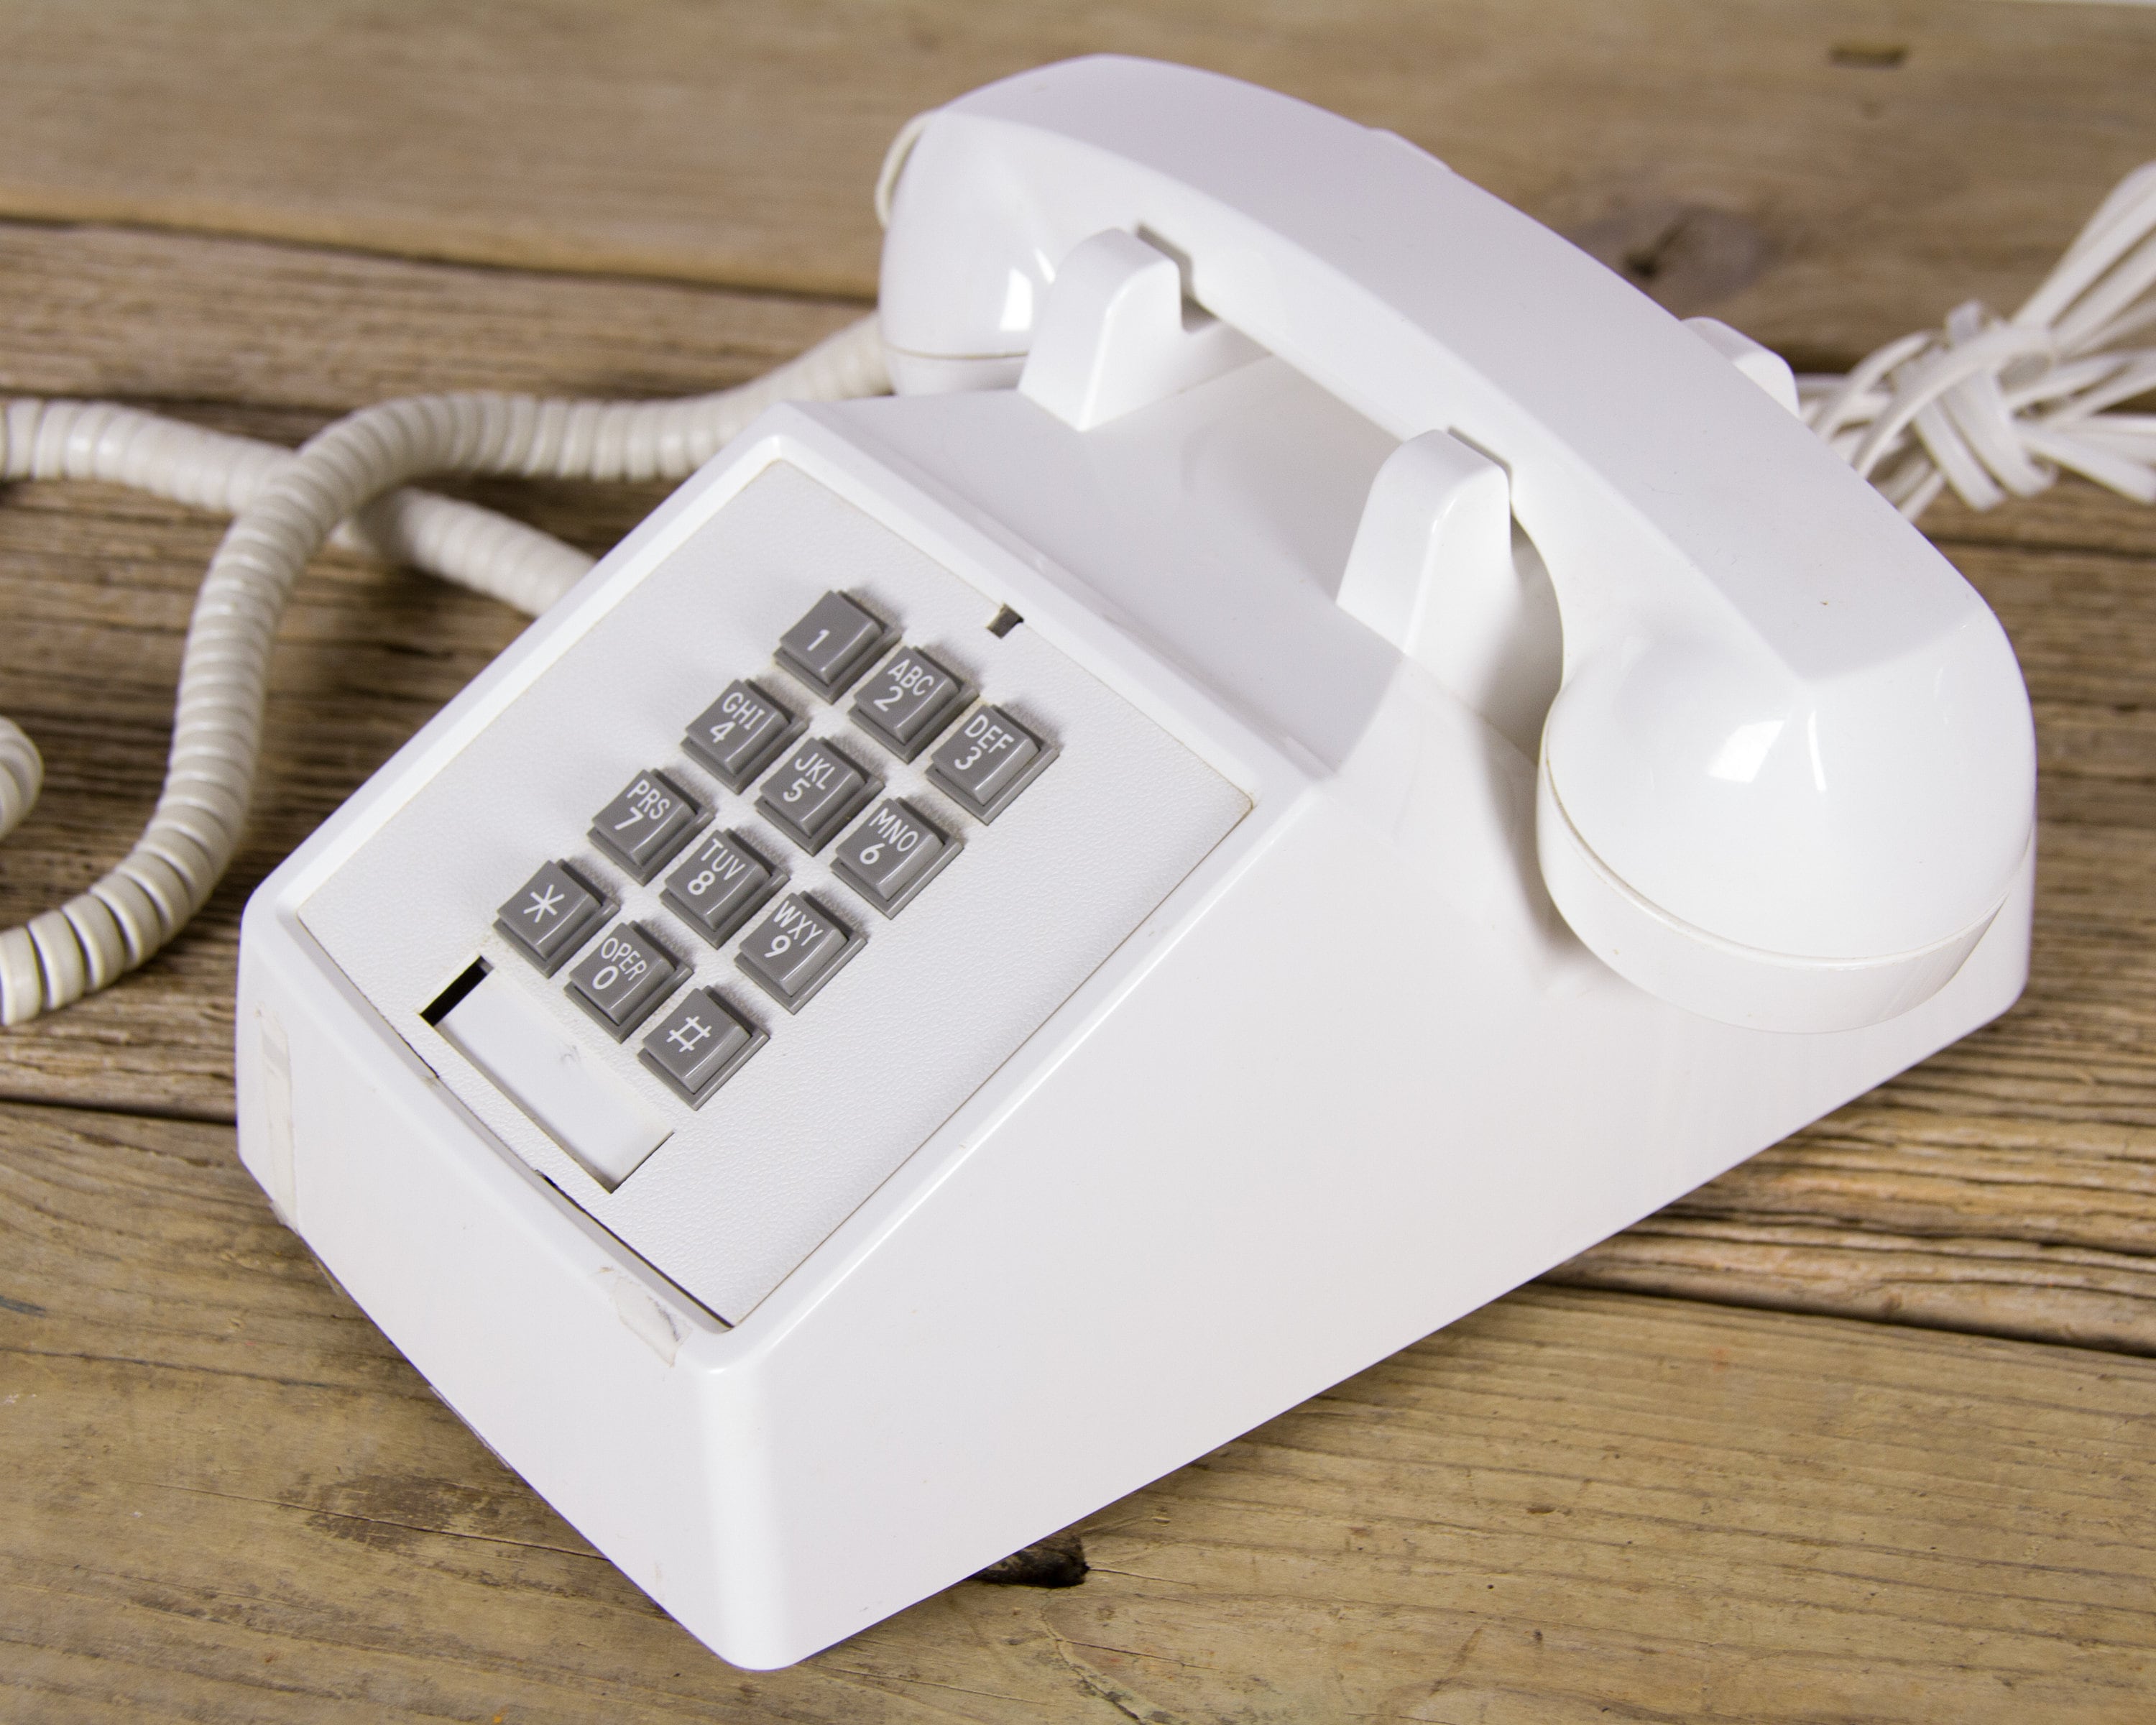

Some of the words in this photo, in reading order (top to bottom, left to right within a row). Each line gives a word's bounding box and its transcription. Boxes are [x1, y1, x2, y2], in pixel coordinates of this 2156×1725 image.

[807, 629, 830, 651] 1
[887, 658, 934, 696] ABC
[722, 691, 766, 730] GHI
[873, 686, 903, 712] 2
[709, 720, 737, 743] 4
[964, 714, 1015, 755] DEF
[794, 753, 836, 791] JKL
[954, 747, 982, 770] 3
[626, 779, 671, 819] PRS
[783, 778, 811, 802] 5
[614, 806, 643, 831] 7
[868, 806, 919, 852] MNO
[700, 839, 746, 881] TUV
[859, 842, 885, 865] 6
[687, 869, 716, 896] 8
[772, 900, 824, 947] WXY
[600, 937, 648, 982] OPER
[764, 934, 792, 959] 9
[591, 965, 619, 990] 0
[665, 1016, 713, 1053] #
